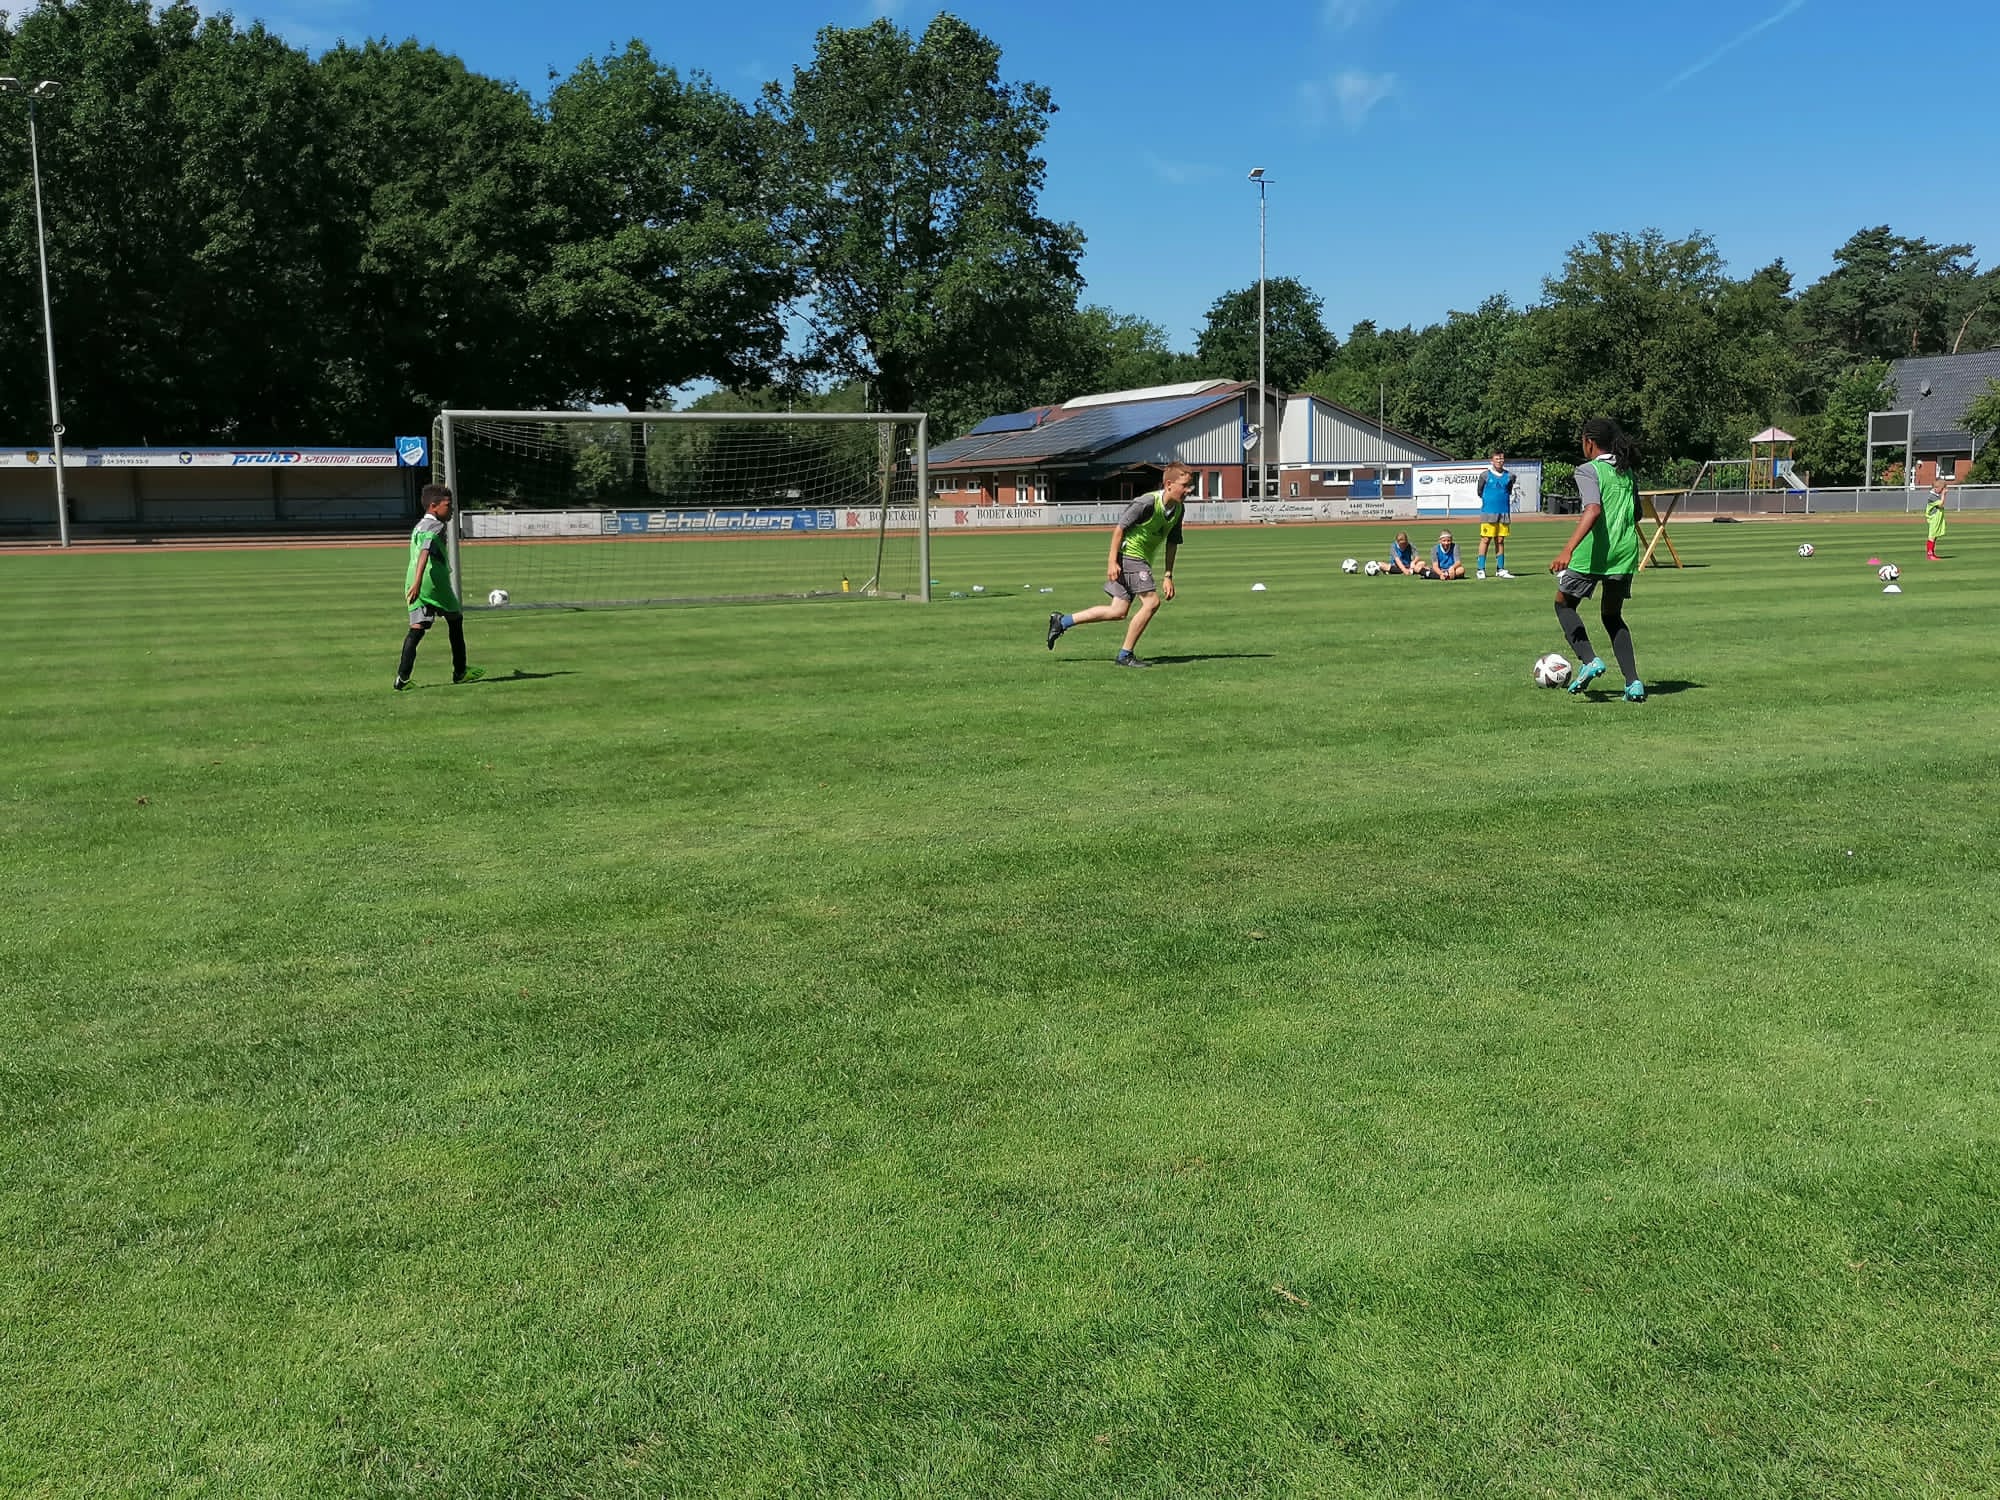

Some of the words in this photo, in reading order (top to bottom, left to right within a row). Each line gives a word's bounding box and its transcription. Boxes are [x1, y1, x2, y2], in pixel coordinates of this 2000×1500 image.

[232, 452, 296, 466] pruhs
[303, 455, 350, 464] SPEDITION
[356, 455, 394, 464] LOGISTIK
[1249, 504, 1275, 514] Rudolf
[647, 512, 794, 530] Schallenberg
[869, 510, 938, 521] BOET&HOST
